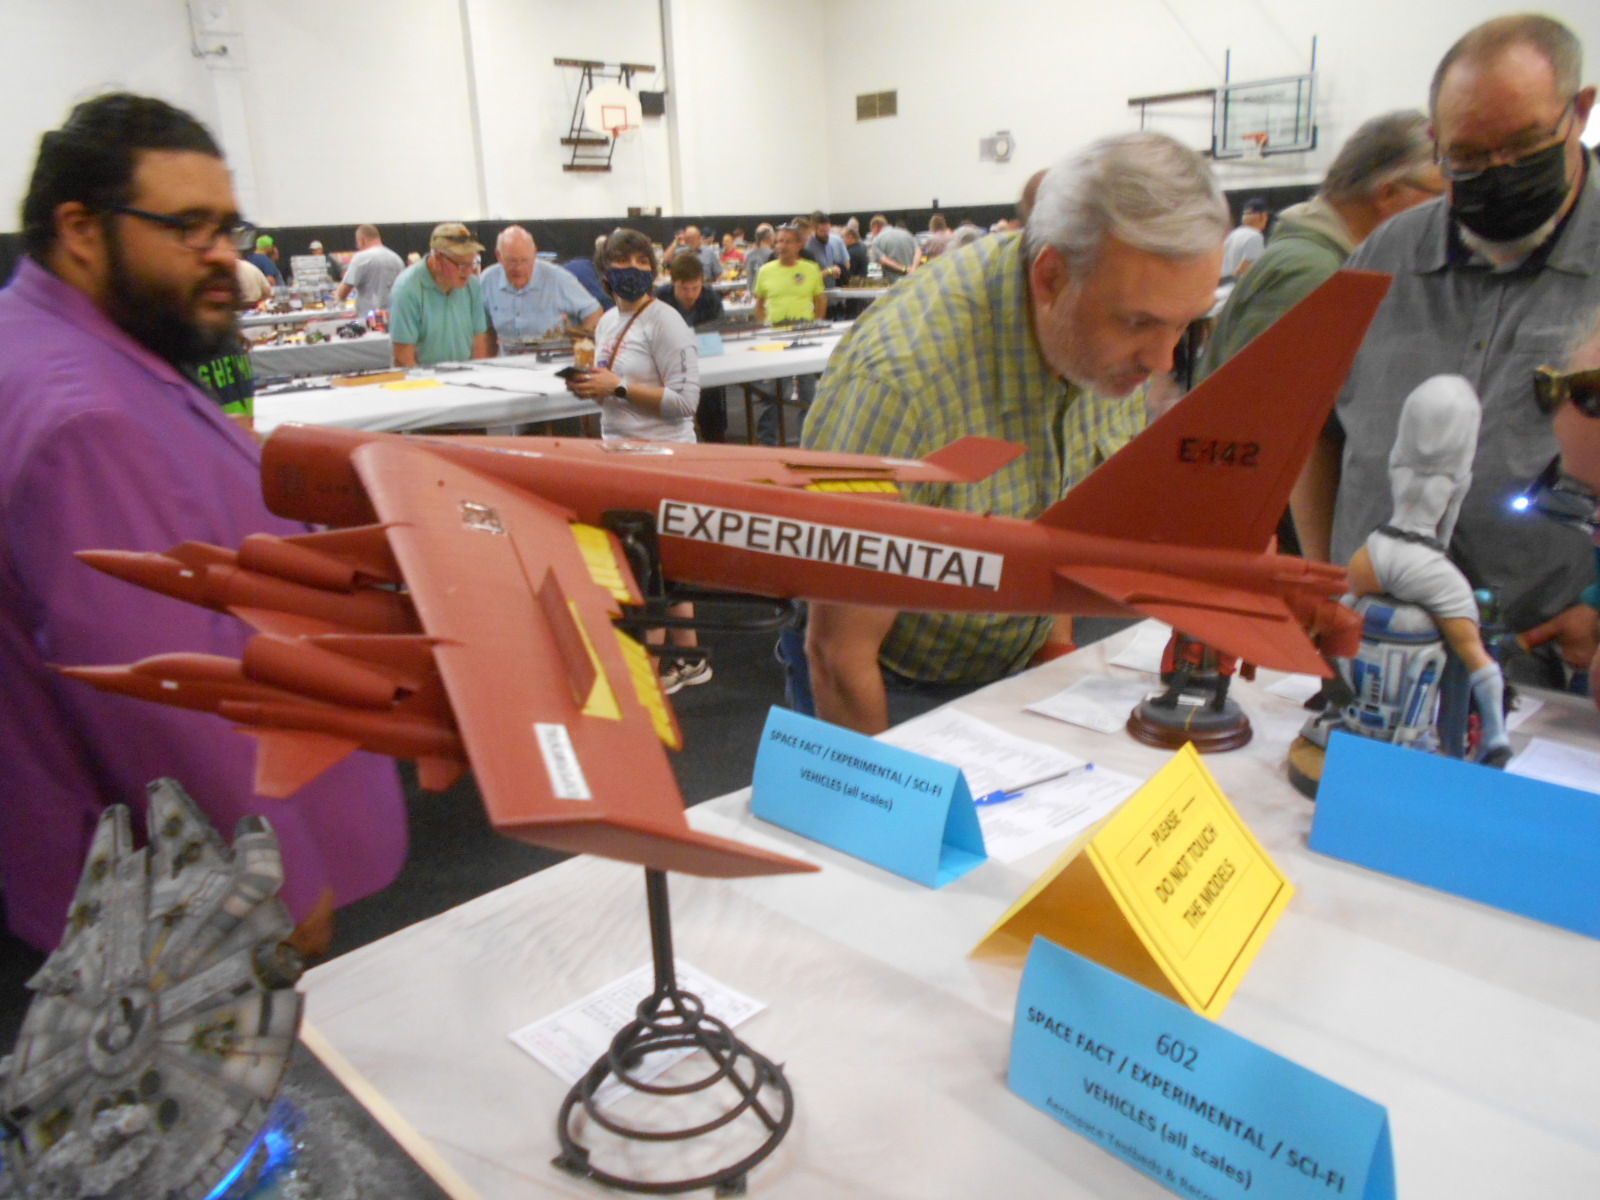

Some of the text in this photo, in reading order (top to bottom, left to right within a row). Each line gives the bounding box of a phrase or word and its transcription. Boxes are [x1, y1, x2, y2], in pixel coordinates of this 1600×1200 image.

[662, 502, 997, 591] EXPERIMENTAL
[770, 730, 797, 747] SPACE
[799, 740, 822, 756] FACT
[830, 749, 903, 785] EXPERIMENTAL
[912, 778, 943, 798] SCI-FI
[800, 767, 893, 812] VEHICLES (all scales)
[1151, 810, 1181, 846] PLEASE
[1155, 823, 1217, 904] DO NOT TOUCH
[1182, 858, 1236, 930] THE MODELS
[1154, 1033, 1200, 1073] 602
[1027, 1006, 1347, 1194] SPACE FACT / EXPERIMENTAL / SCI-FI
[1083, 1076, 1254, 1191] VEHICLES (all scales)
